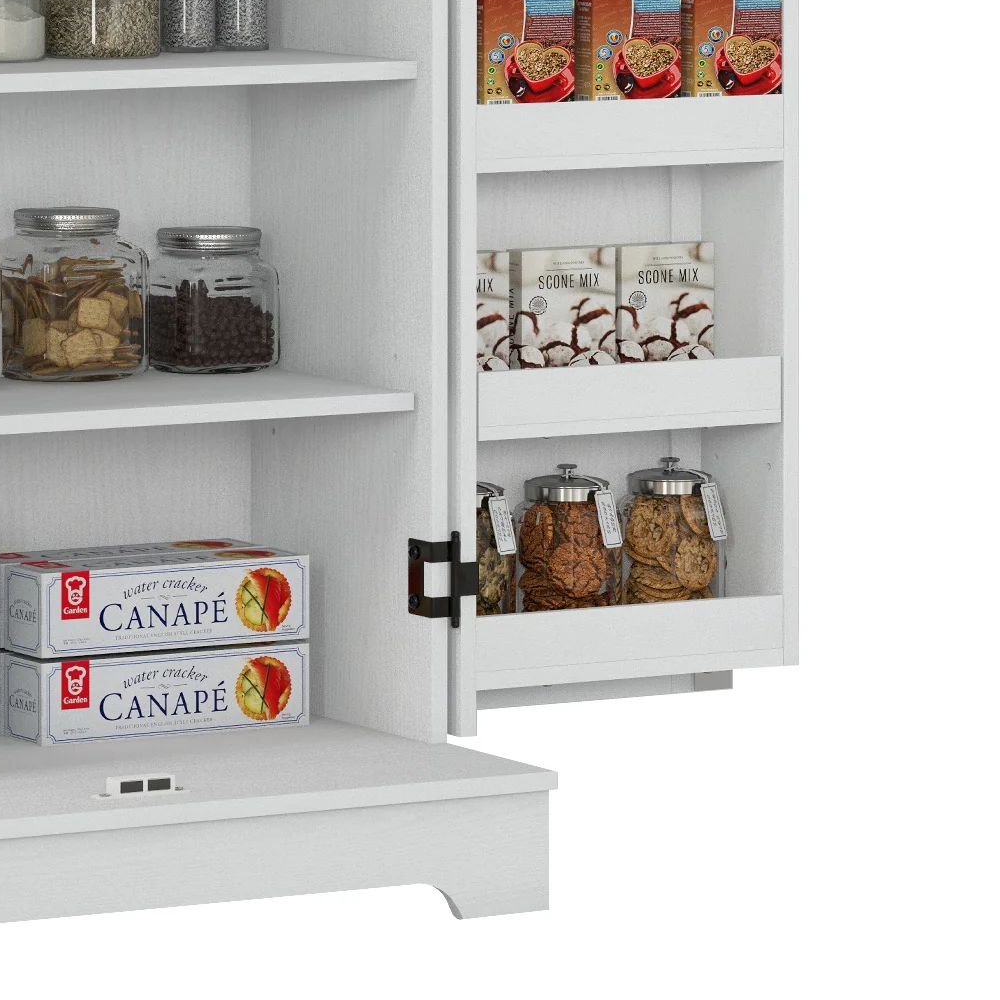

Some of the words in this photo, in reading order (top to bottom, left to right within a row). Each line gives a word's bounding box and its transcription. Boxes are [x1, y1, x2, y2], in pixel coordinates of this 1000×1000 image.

[538, 274, 575, 290] SCONE
[579, 272, 600, 288] MIX
[638, 269, 674, 284] SCONE
[679, 267, 699, 283] MIX
[123, 580, 160, 600] water
[162, 577, 208, 593] cracker
[9, 604, 37, 623] CANAPÉ
[63, 607, 88, 615] Garden
[99, 591, 229, 632] CANAPÉ
[123, 669, 160, 689] water
[162, 665, 208, 683] cracker
[9, 694, 37, 713] CANAPÉ
[63, 697, 88, 705] Garden
[99, 680, 229, 721] CANAPÉ
